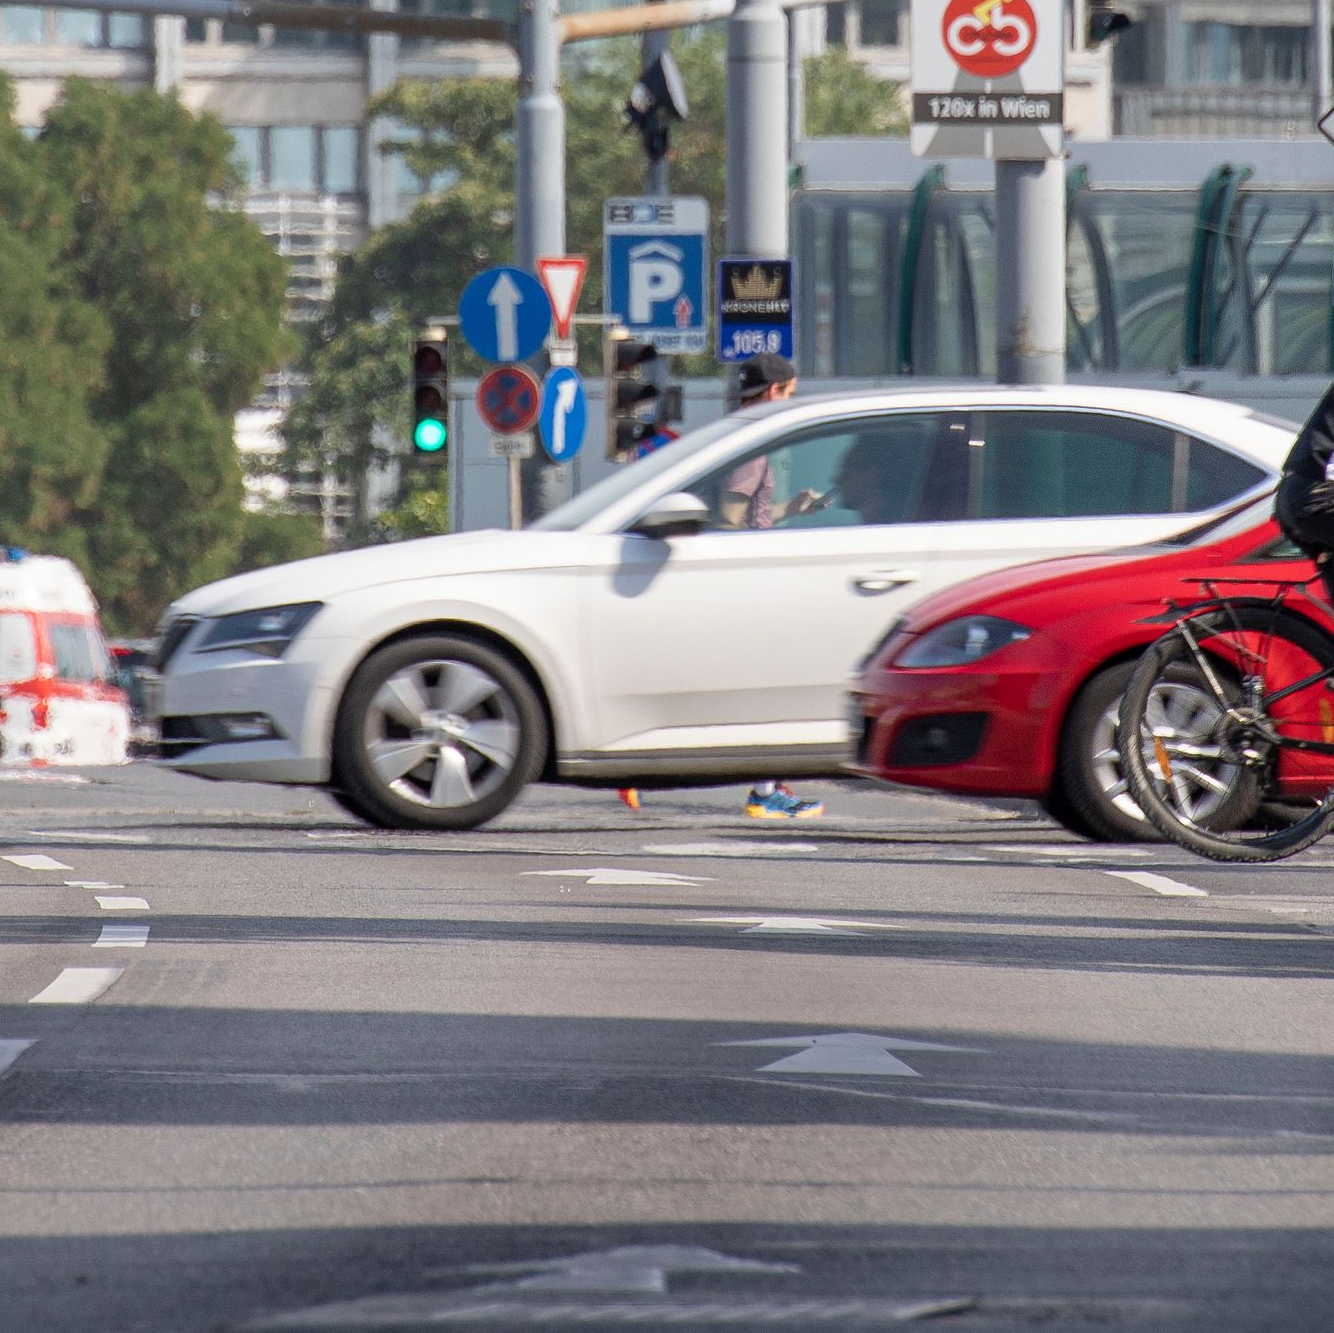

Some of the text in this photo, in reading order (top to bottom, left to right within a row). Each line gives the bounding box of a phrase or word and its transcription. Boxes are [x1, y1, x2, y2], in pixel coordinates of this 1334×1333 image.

[928, 96, 1050, 118] 120x in Wien
[629, 259, 684, 324] P
